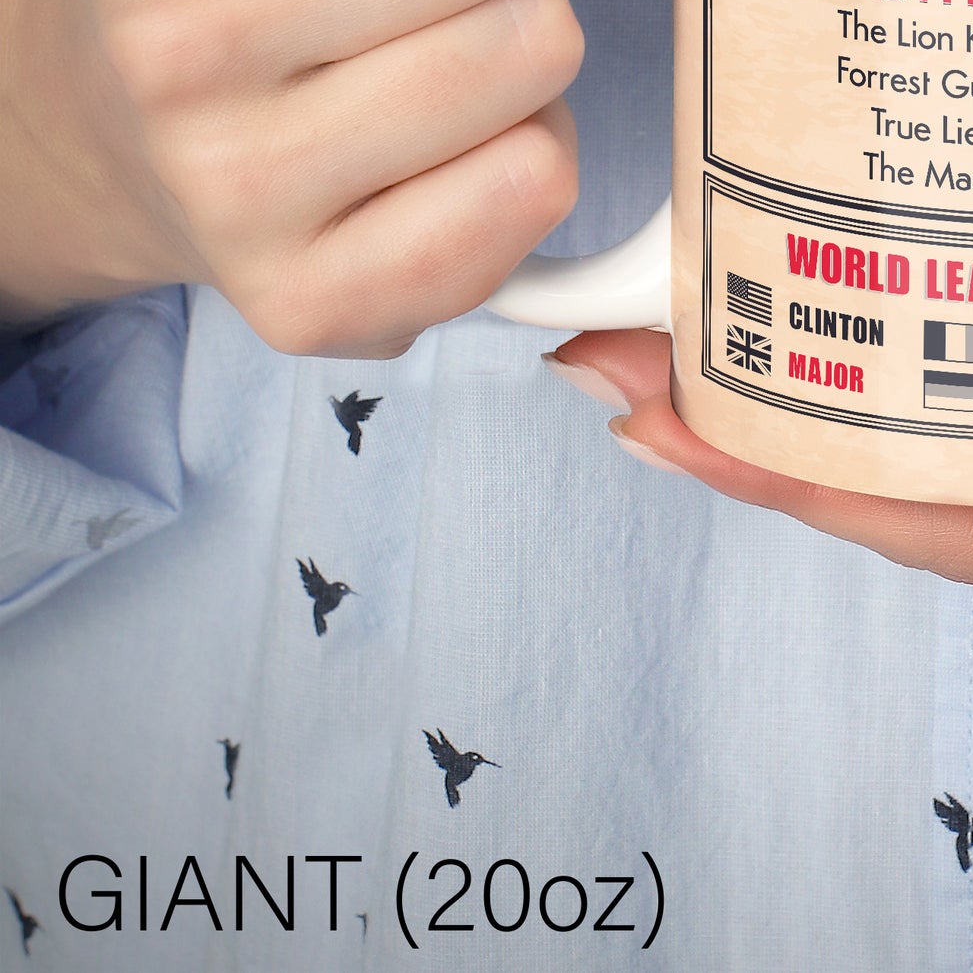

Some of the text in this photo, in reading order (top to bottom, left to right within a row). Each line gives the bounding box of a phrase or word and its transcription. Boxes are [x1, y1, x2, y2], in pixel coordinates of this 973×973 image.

[837, 9, 887, 45] The
[897, 18, 954, 53] Lion
[837, 56, 931, 95] Forrest
[871, 107, 931, 141] True
[863, 151, 915, 186] The
[786, 233, 910, 294] WORLD
[788, 302, 885, 347] CLINTON
[787, 351, 865, 393] MAJOR
